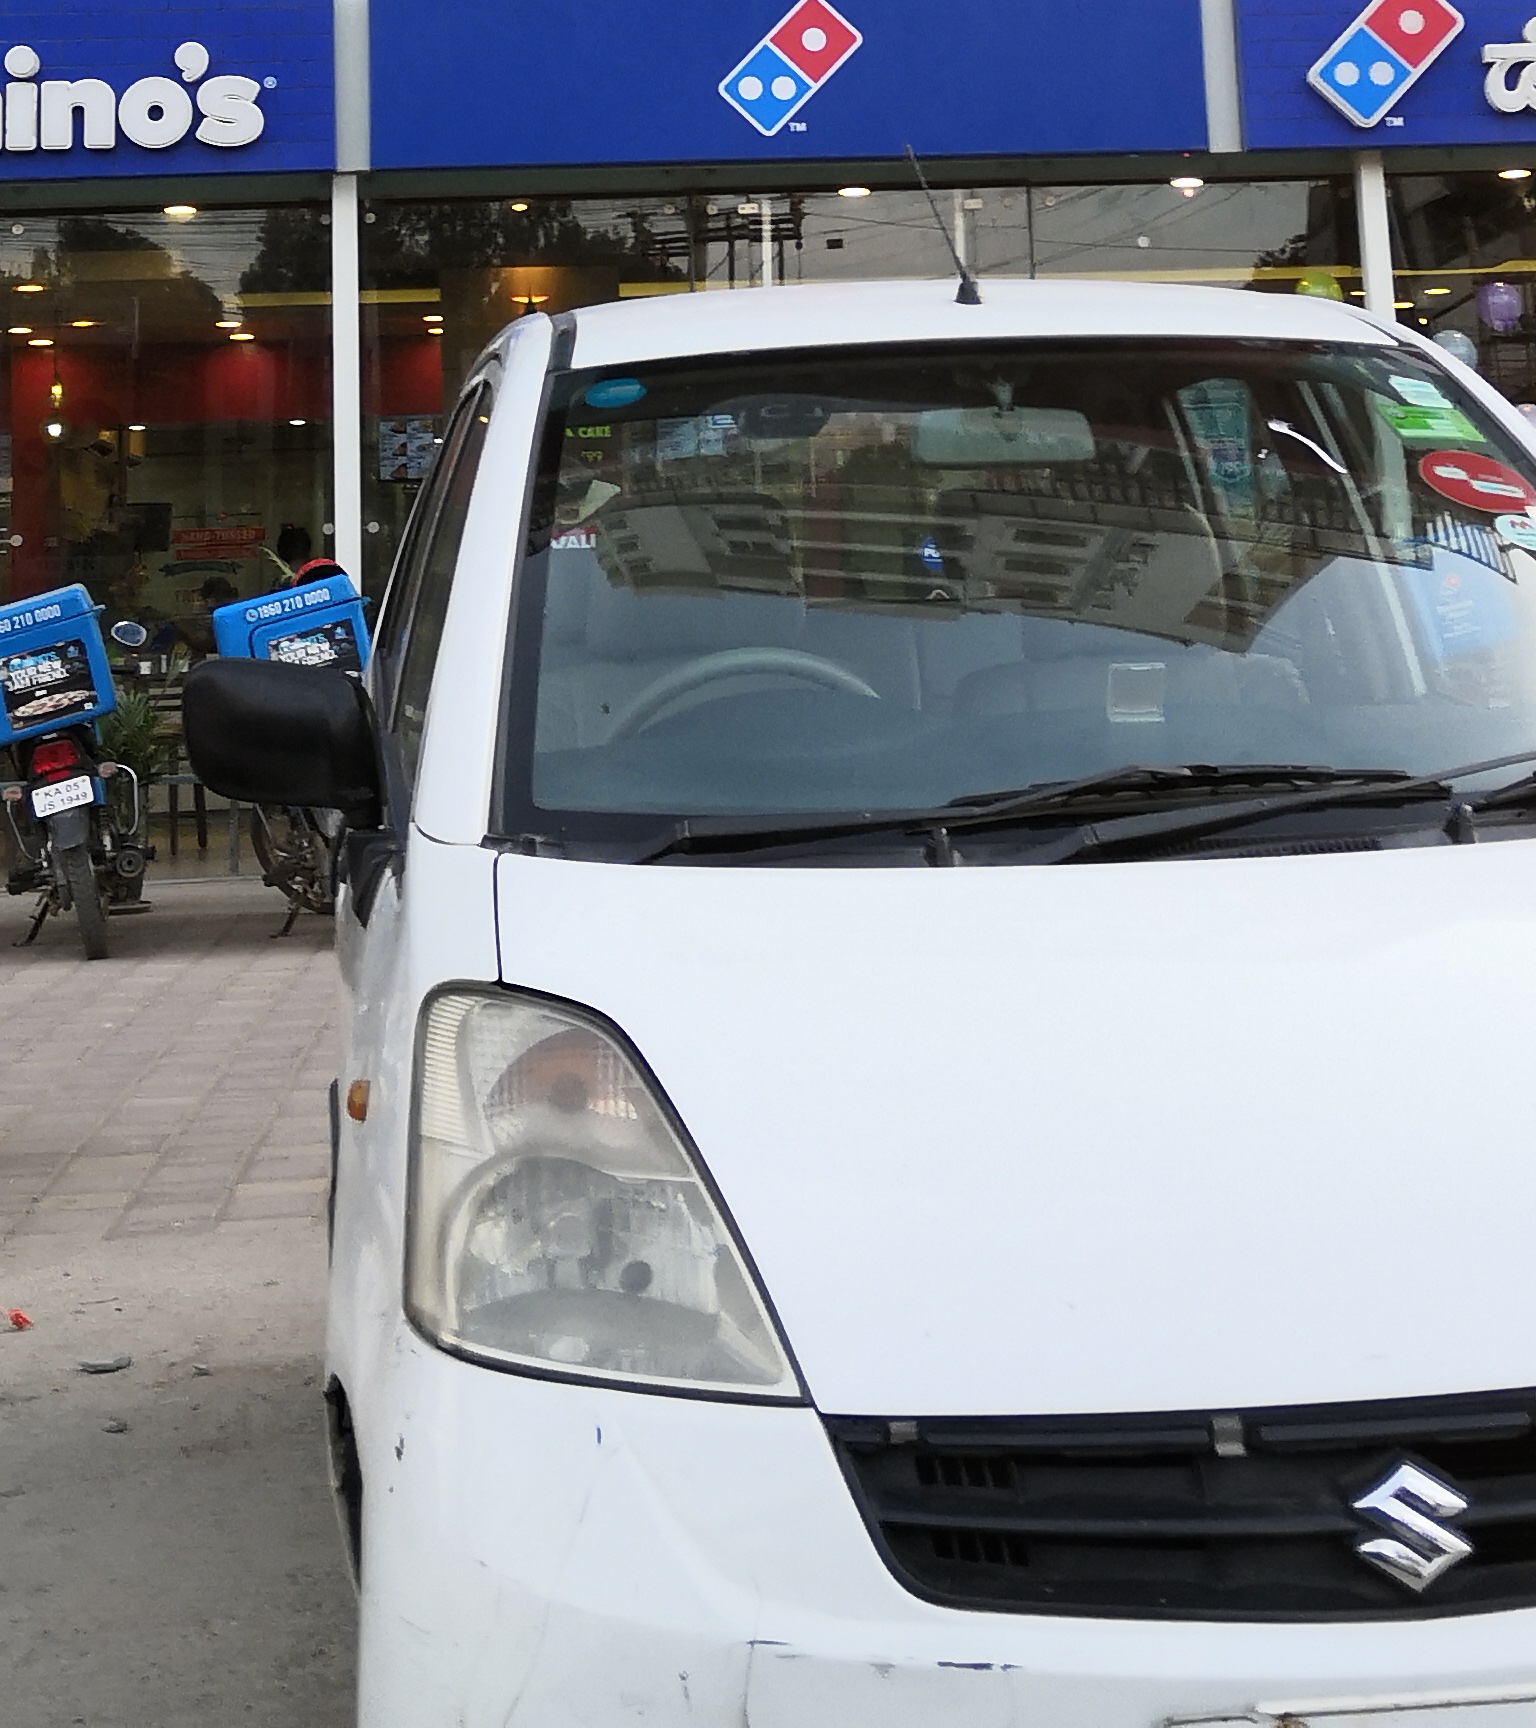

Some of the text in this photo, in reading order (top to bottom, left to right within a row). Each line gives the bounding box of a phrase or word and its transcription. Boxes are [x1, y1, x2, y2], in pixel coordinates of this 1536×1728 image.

[13, 611, 32, 630] 210
[43, 787, 63, 800] KA
[39, 798, 56, 813] JS
